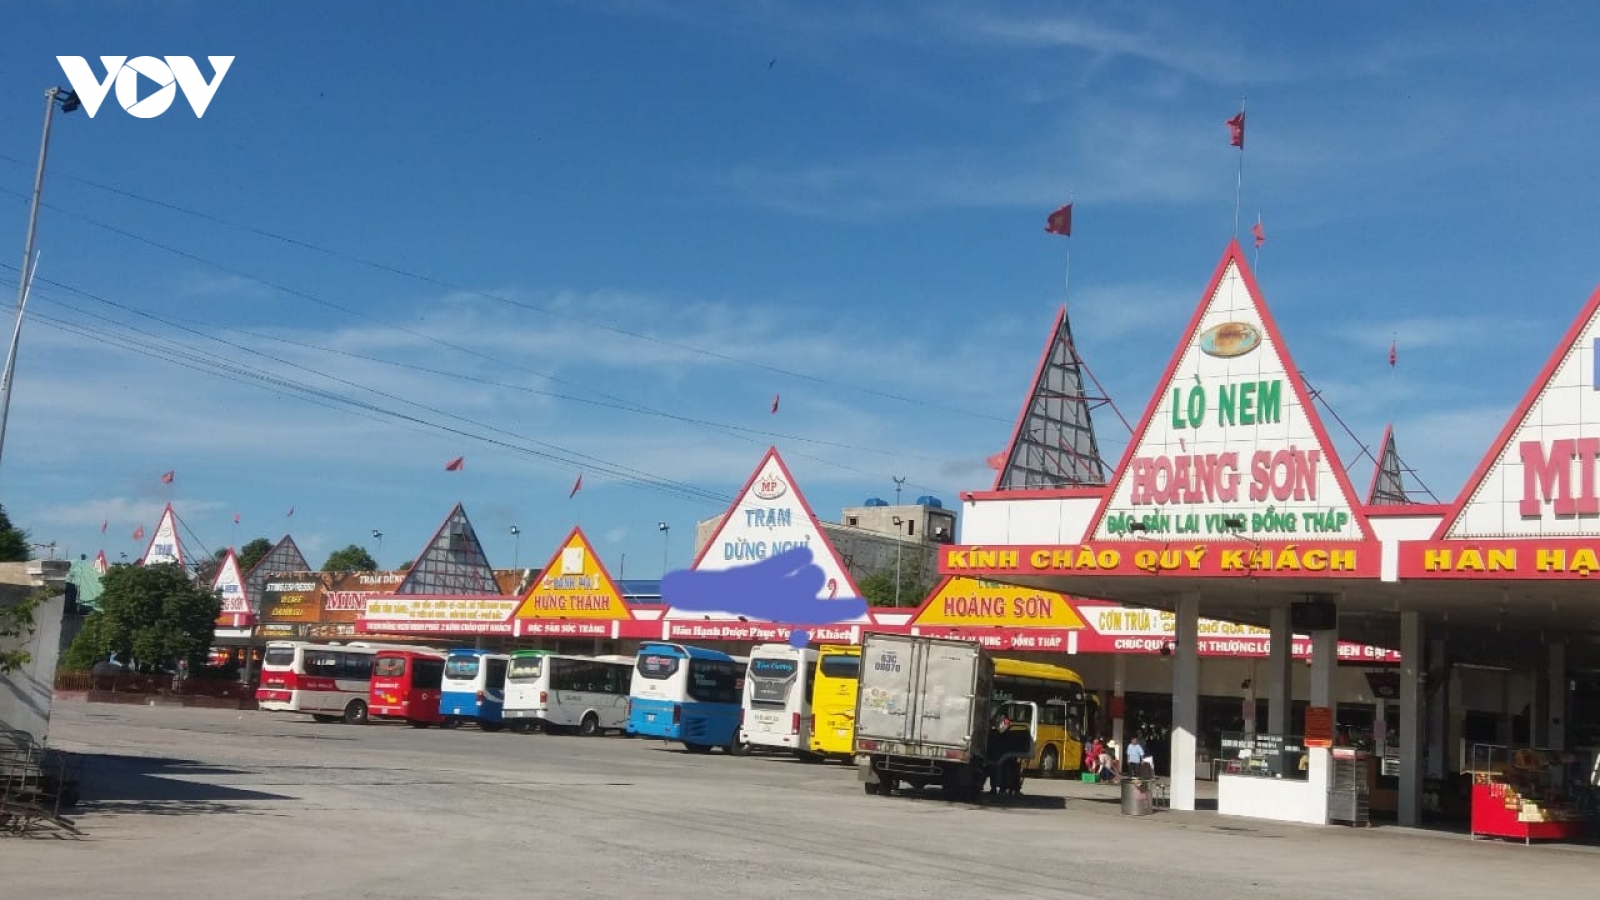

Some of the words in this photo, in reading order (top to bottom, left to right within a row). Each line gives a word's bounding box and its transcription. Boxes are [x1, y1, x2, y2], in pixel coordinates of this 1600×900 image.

[1172, 374, 1205, 429] LÒ
[1219, 380, 1280, 427] NEM
[1131, 439, 1240, 506] HOÀNG
[1250, 446, 1320, 502] SƠN
[761, 482, 777, 492] MP
[745, 509, 791, 530] TRẠM
[1142, 509, 1170, 533] SẢN
[1175, 514, 1200, 533] LAI
[1252, 505, 1296, 534] ĐỒNG
[1302, 507, 1348, 533] THÁP
[724, 537, 767, 561] DỪNG
[947, 545, 1018, 571] KÍNH
[1030, 545, 1121, 572] CHÀO
[1134, 545, 1206, 574] QUÝ
[1221, 545, 1358, 572] KHÁCH
[944, 592, 1005, 617] HOÀNG
[1013, 594, 1052, 618] SƠN
[1099, 609, 1122, 631] CƠM
[1124, 609, 1151, 631] TRƯA
[1114, 636, 1144, 650] CHÚC
[1208, 639, 1256, 655] THƯỢNG
